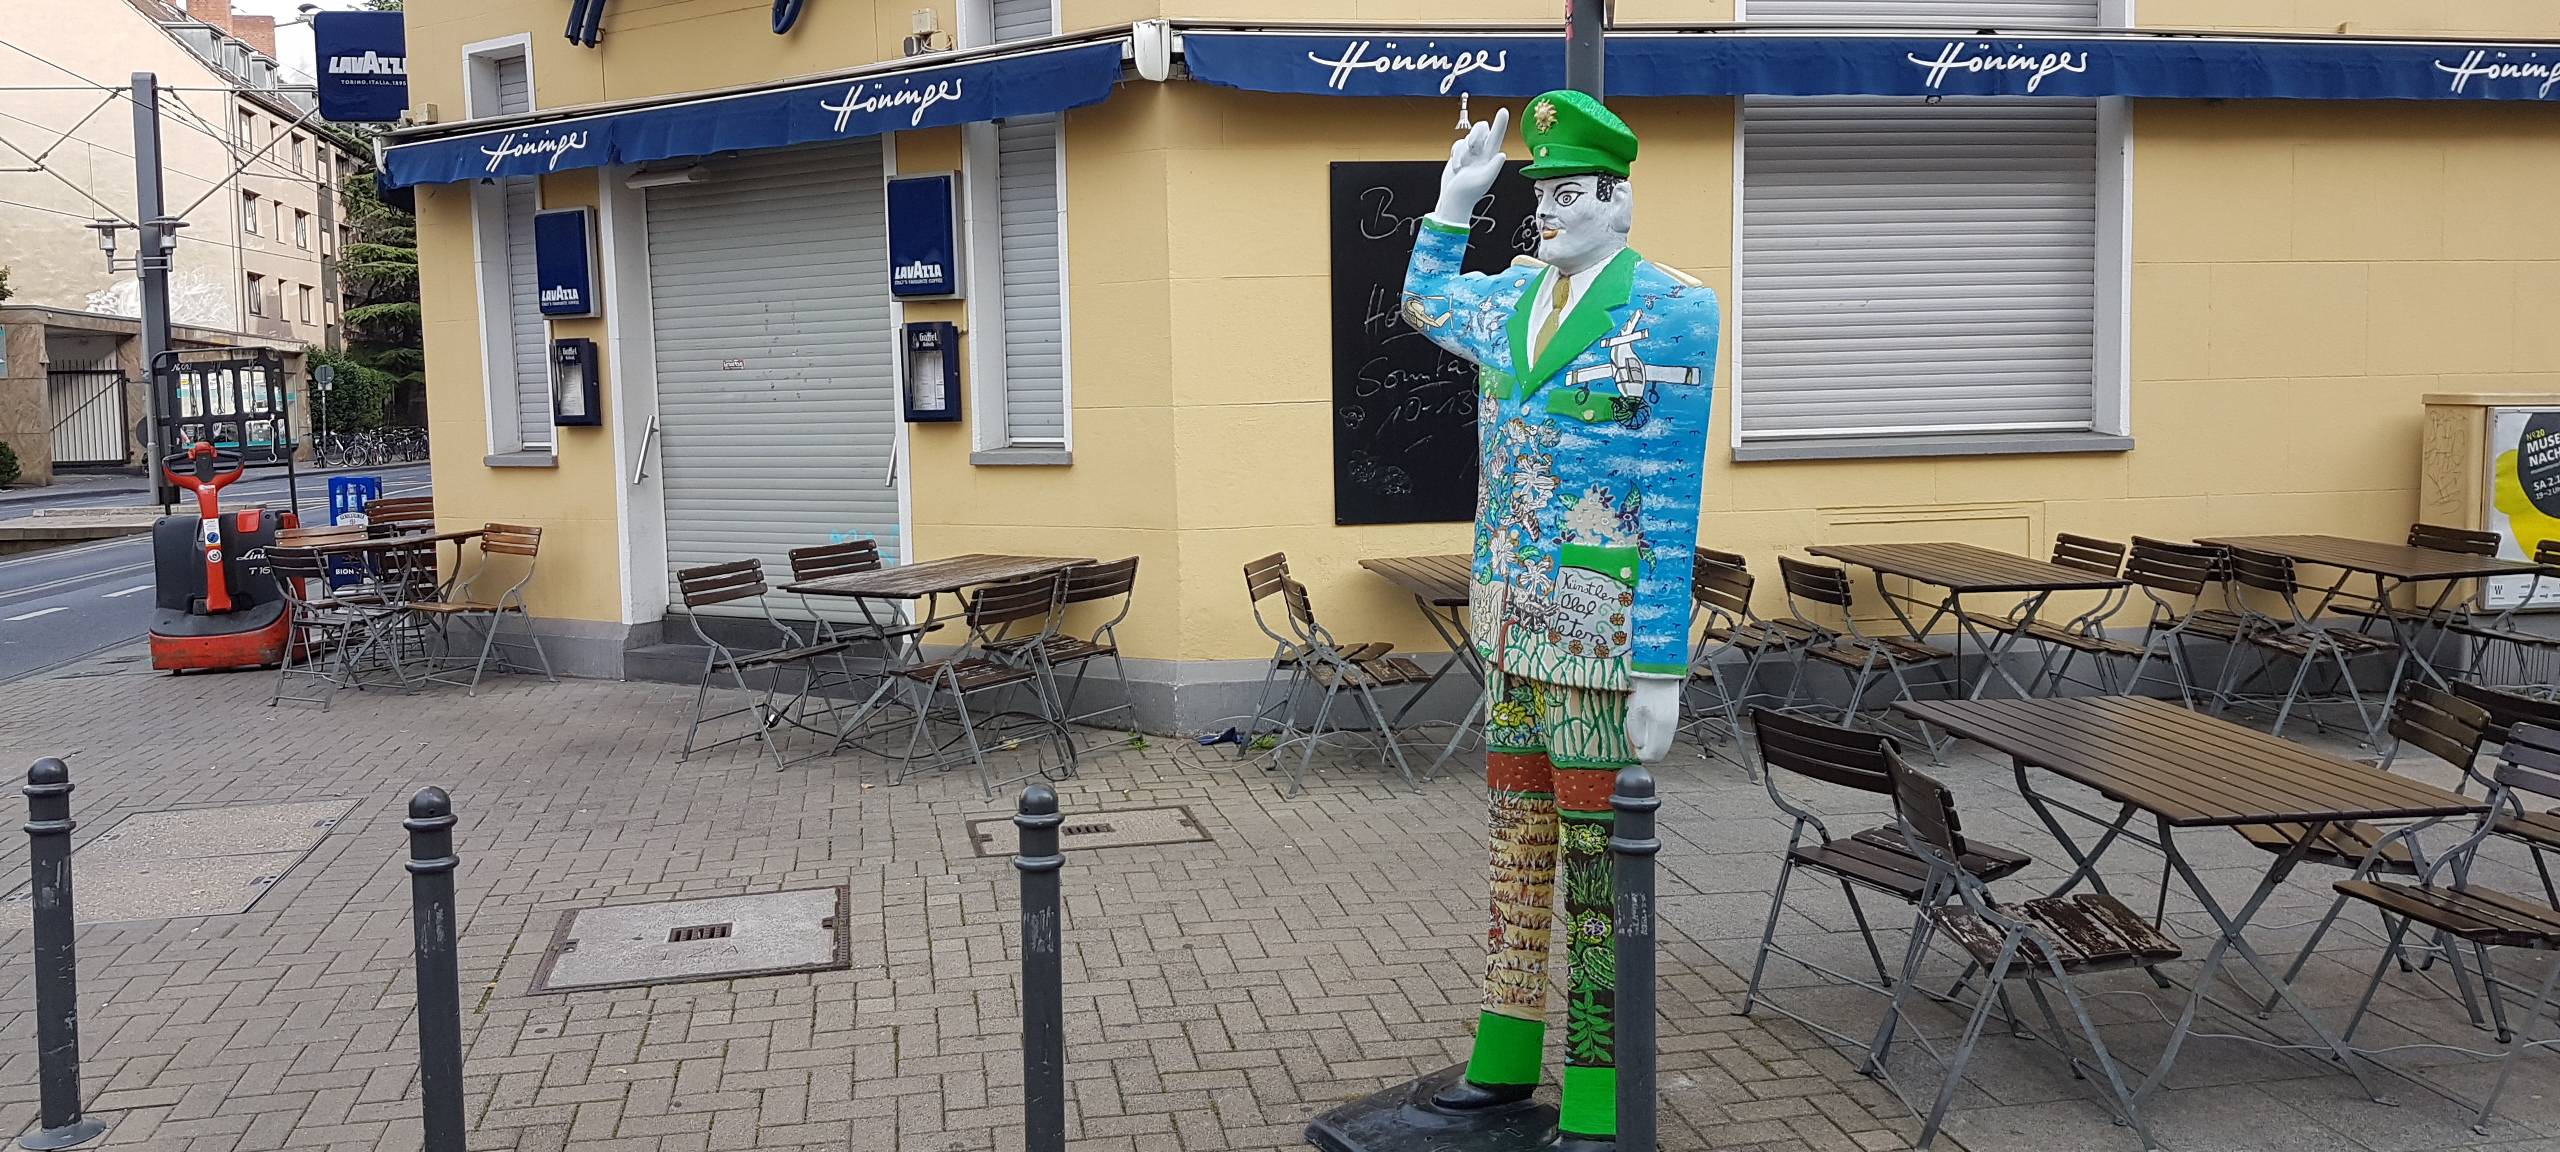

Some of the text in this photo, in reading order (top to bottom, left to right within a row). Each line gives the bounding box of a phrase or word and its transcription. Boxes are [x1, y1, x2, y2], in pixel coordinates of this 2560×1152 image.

[328, 50, 407, 75] LAVAZZ
[1307, 40, 1507, 95] Höninger
[1907, 41, 2088, 93] Höninger
[820, 78, 962, 133] Höninger
[480, 129, 588, 173] Höninger
[895, 260, 943, 280] LAVAZZA
[541, 285, 579, 302] LAVAZZA
[2533, 479, 2547, 491] SA
